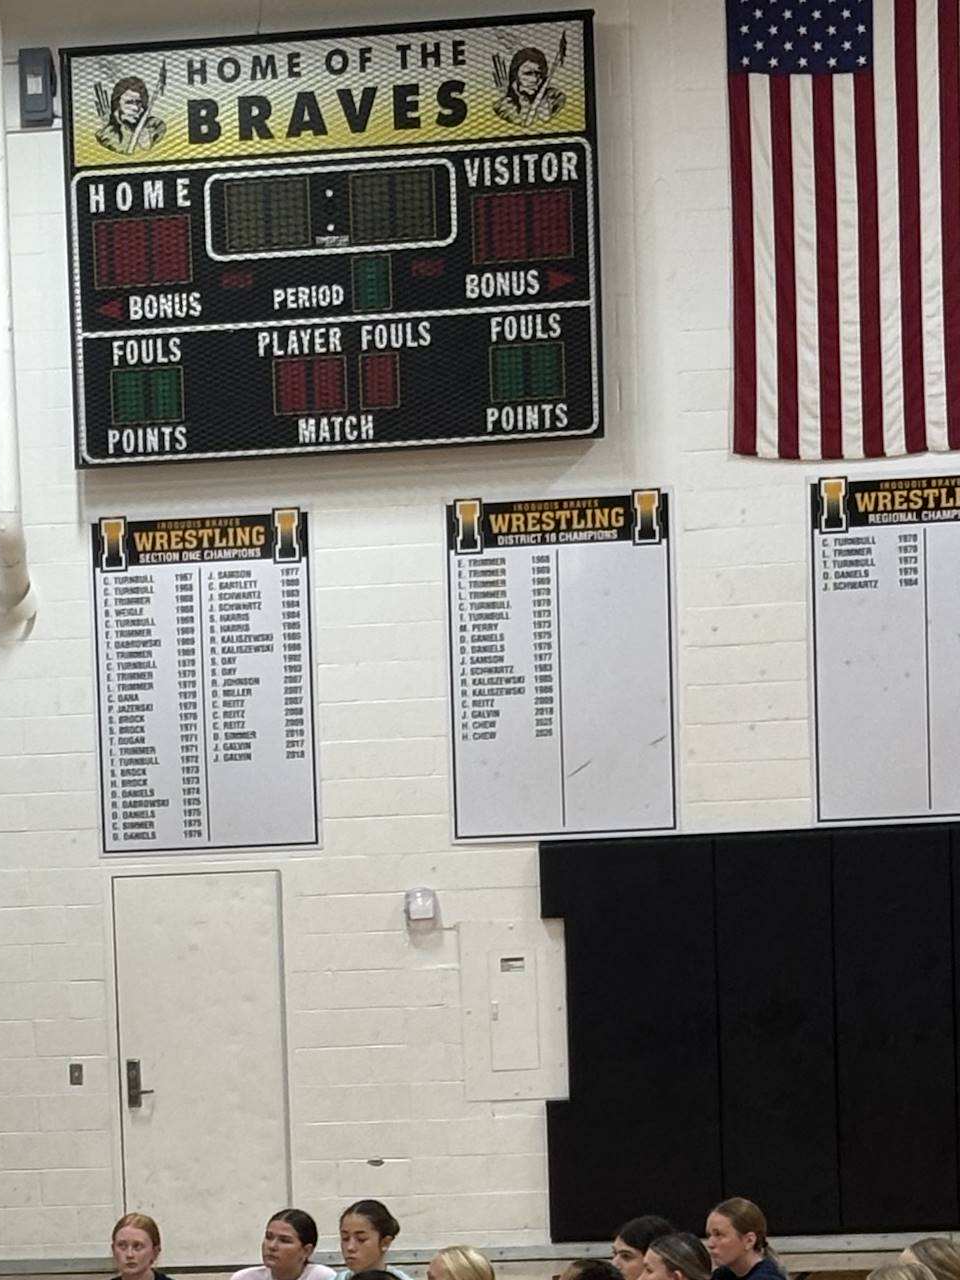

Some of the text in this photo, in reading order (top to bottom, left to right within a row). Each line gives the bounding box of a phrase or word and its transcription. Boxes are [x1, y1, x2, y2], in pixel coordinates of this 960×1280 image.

[187, 40, 467, 85] HOME OF THE
[187, 80, 468, 144] BRAVES
[464, 151, 578, 188] VISITOR
[89, 178, 192, 213] HOME
[465, 269, 540, 299] BONUS
[273, 284, 344, 311] PERIOD
[129, 292, 202, 320] BONUS
[490, 313, 563, 342] FOULS
[258, 321, 432, 357] PLAYER FOULS
[112, 337, 182, 366] FOULS
[486, 403, 569, 433] POINTS
[298, 415, 374, 444] MATCH
[108, 425, 188, 455] POINTS
[880, 480, 928, 490] IROQUOIS
[513, 499, 599, 512] IROQUOIS BRAVES
[157, 517, 240, 530] IROQUOIS BRAVES
[489, 507, 624, 534] WRESTLING
[868, 513, 919, 524] REGIONAL
[133, 526, 265, 551] WRESTLING
[497, 534, 542, 546] DISTRICT
[558, 529, 617, 542] CHAMPIONS
[833, 536, 876, 546] TURNBULL
[139, 548, 261, 563] SECTION ONE CHAMPIONS
[831, 558, 875, 568] TURNBULL
[834, 569, 869, 579] DANIELS
[832, 580, 878, 590] SCHWARTZ
[471, 622, 498, 632] PERRY
[470, 633, 504, 643] DANIELS
[470, 644, 505, 654] DANIELS
[469, 654, 504, 665] SAMSON
[222, 676, 260, 687] JOHNSON
[222, 687, 252, 697] MILLER
[471, 698, 495, 708] REITZ
[222, 709, 245, 719] REITZ
[471, 709, 500, 719] GALVIN
[118, 756, 160, 766] TURNBULL
[121, 788, 155, 798] DANIELS
[122, 831, 156, 841] DANIELS
